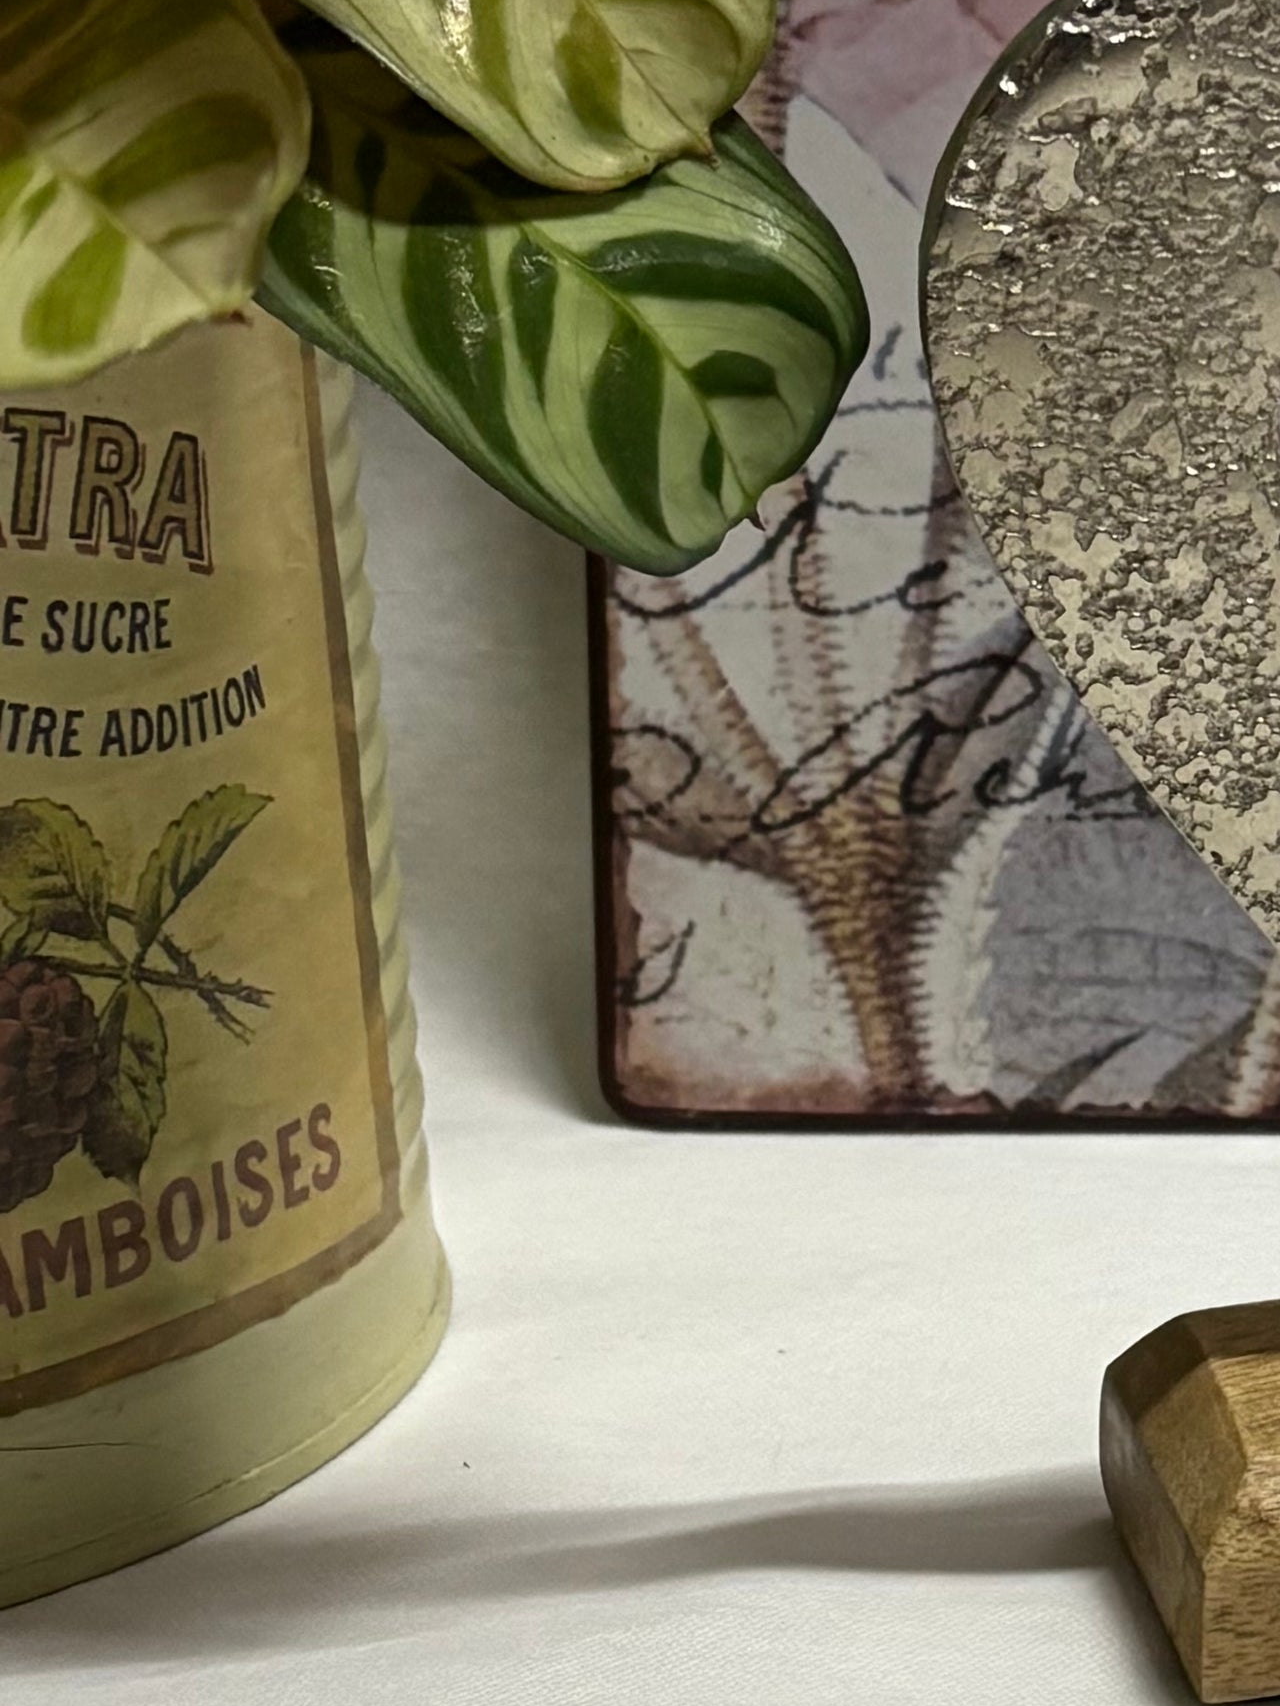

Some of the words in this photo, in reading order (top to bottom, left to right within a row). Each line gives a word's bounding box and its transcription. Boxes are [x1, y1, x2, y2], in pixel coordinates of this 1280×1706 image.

[0, 407, 214, 575] TRA
[40, 597, 173, 655] SUCRE
[0, 699, 85, 758] TRE
[98, 664, 266, 758] ADDITION
